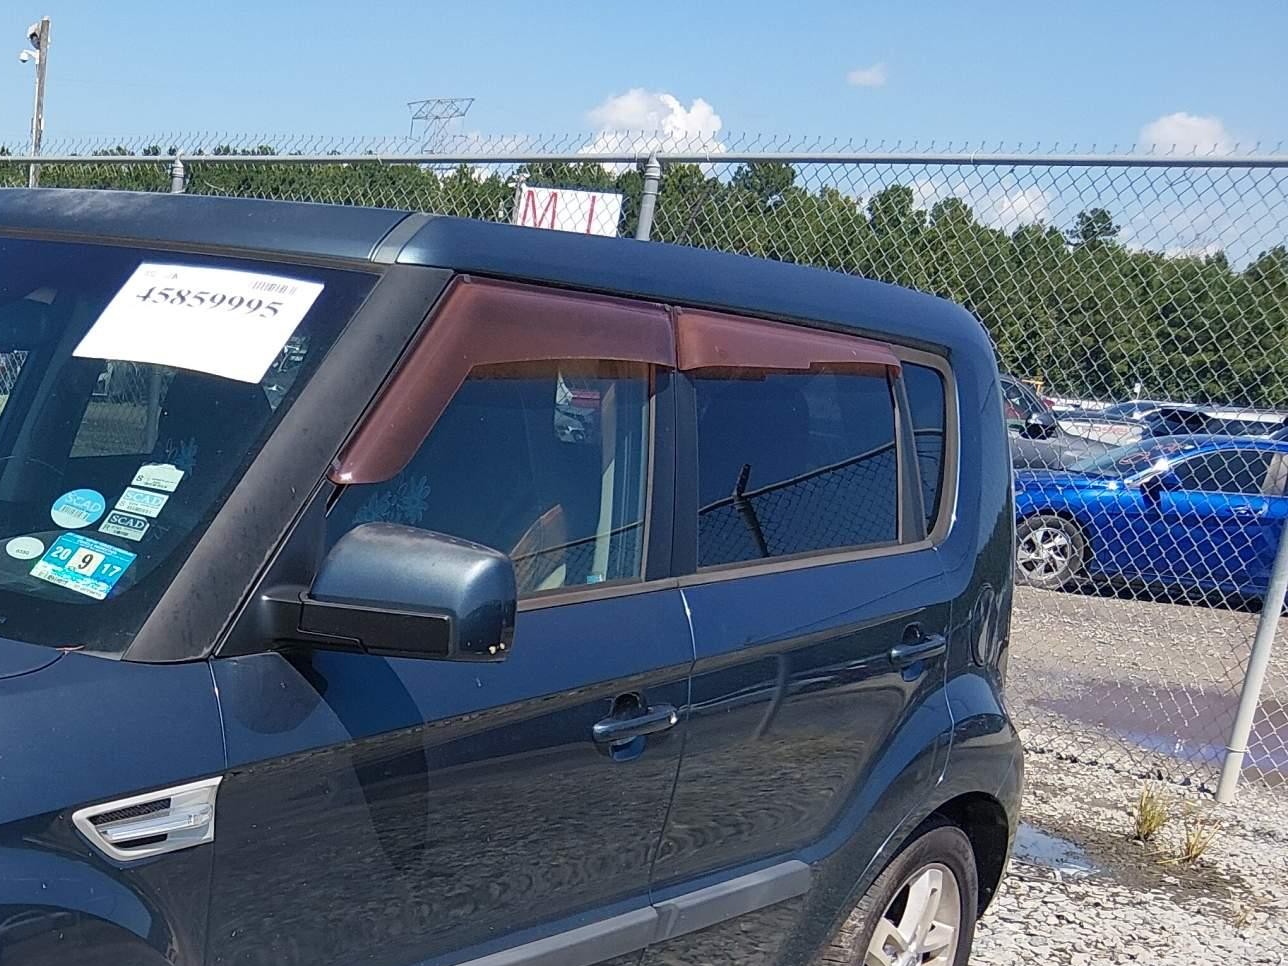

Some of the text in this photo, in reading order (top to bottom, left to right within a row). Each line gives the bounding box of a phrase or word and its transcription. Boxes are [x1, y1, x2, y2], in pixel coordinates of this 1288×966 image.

[136, 286, 283, 318] 45859995
[65, 494, 101, 512] SCAD
[124, 491, 160, 506] SCAD
[110, 515, 144, 529] SCAD
[51, 546, 72, 561] 20
[78, 553, 93, 570] 9
[102, 563, 121, 577] 17
